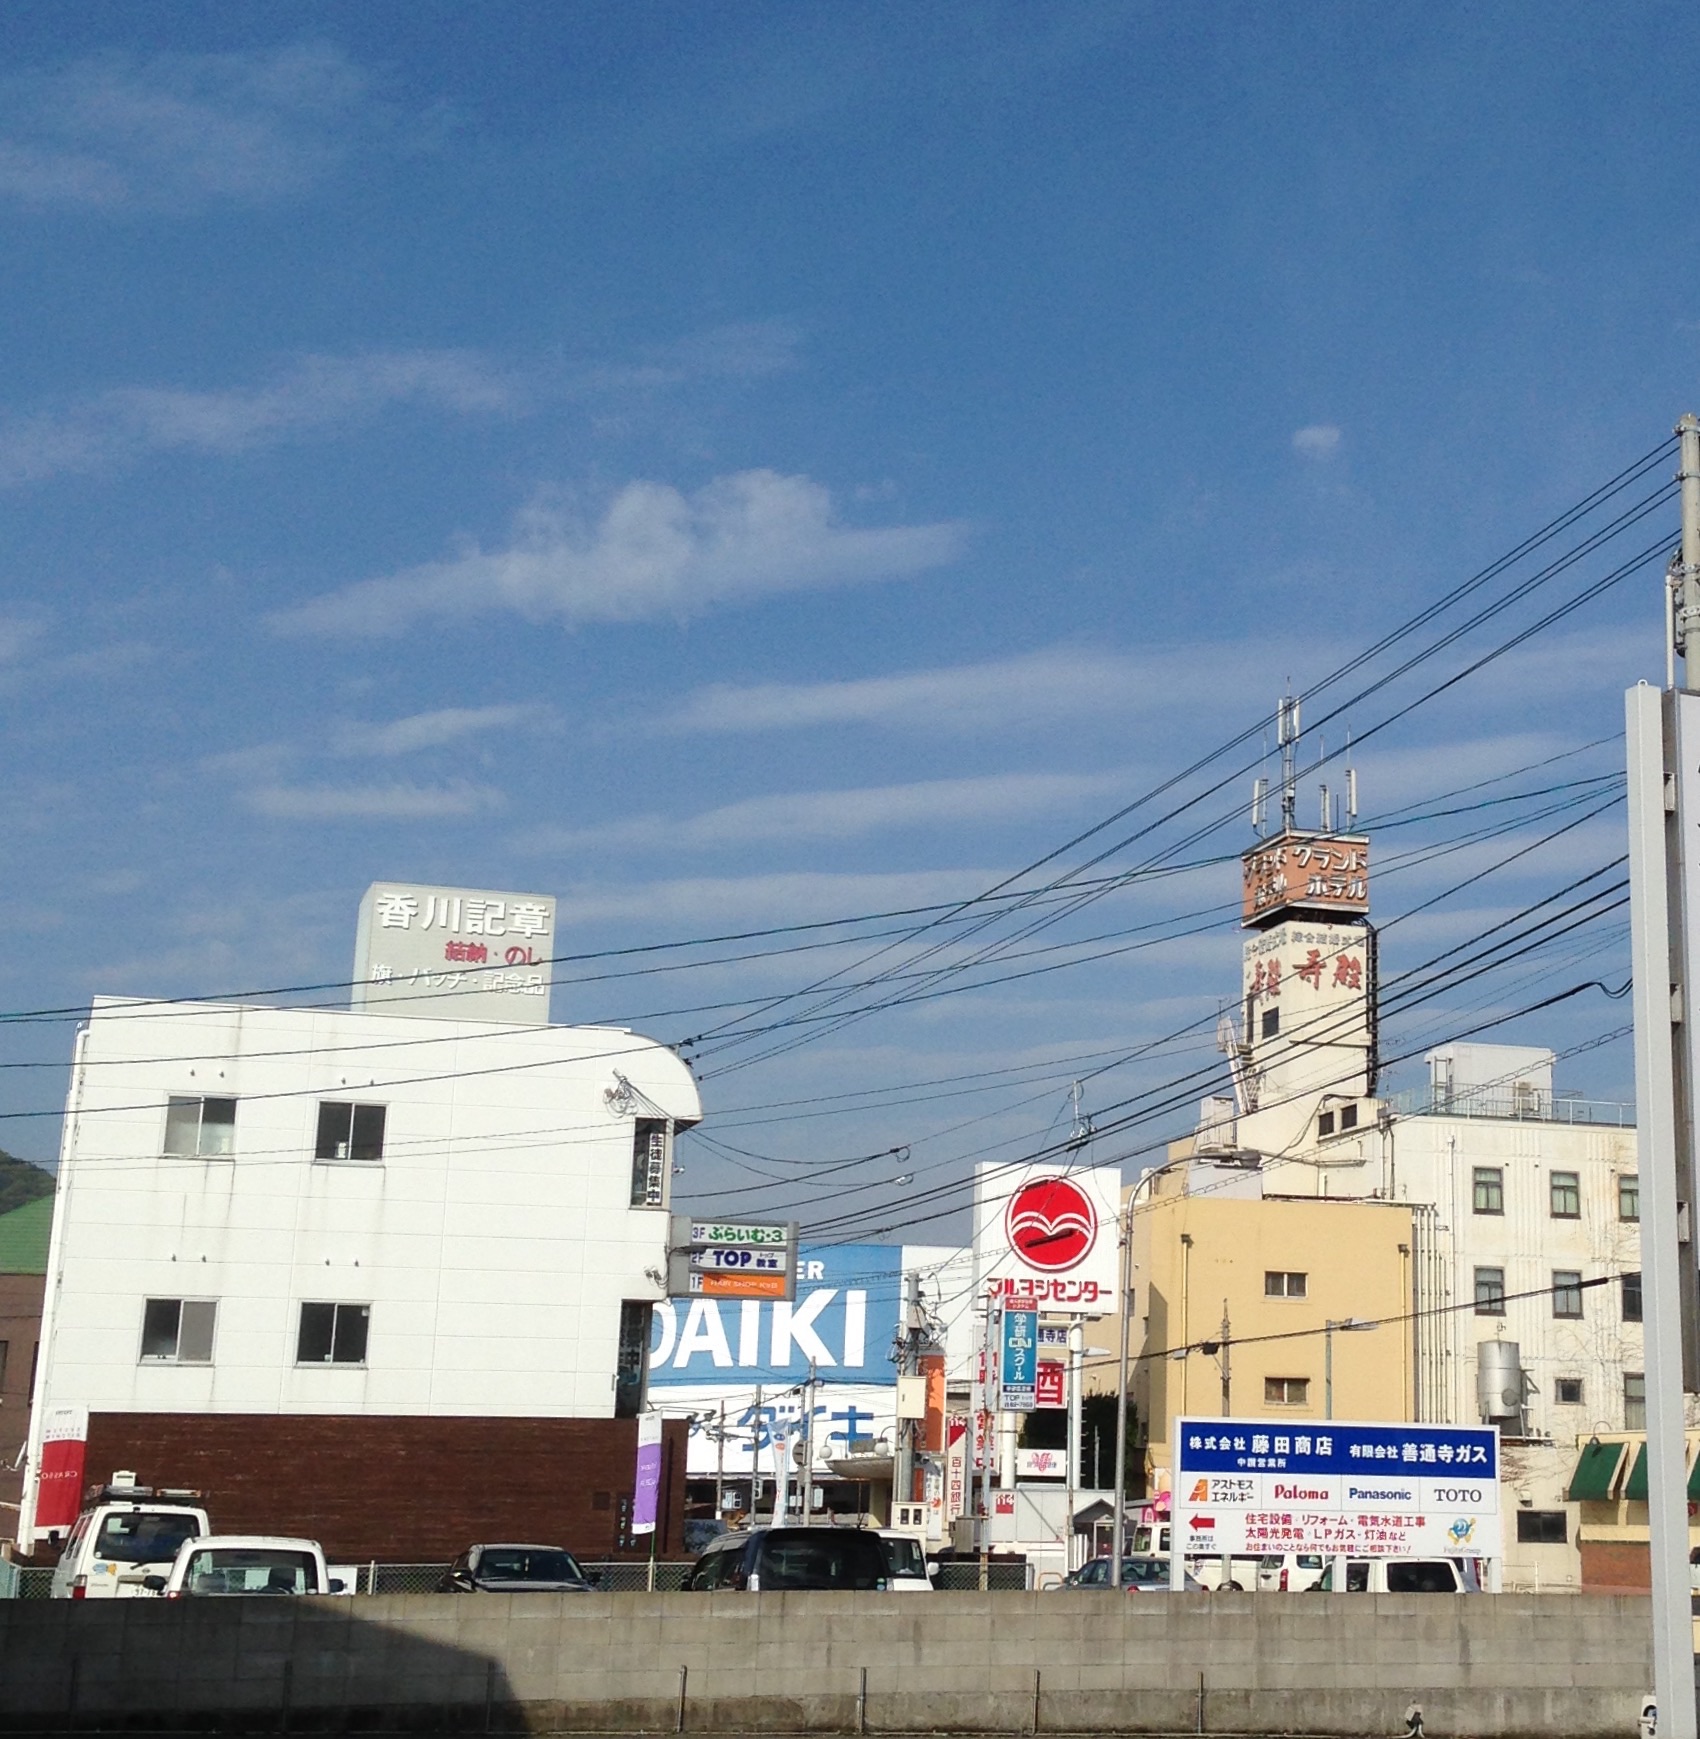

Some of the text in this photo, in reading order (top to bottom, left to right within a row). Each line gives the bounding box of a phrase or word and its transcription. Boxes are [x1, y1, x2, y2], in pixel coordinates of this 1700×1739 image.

[1305, 873, 1367, 900] ホテル
[377, 893, 550, 938] 香川記章
[692, 1227, 706, 1240] 3F
[713, 1250, 752, 1268] TOP
[691, 1276, 703, 1290] 1F
[737, 1405, 875, 1453] ダイキ
[1189, 1434, 1488, 1463] 株式会社 藤田商店 有限会社 善通寺ガス
[951, 1456, 962, 1515] 百十四銀行
[1211, 1479, 1254, 1490] アストモス
[1274, 1484, 1329, 1500] Paloma
[1211, 1492, 1254, 1503] エネルギー
[1349, 1487, 1412, 1500] Panasonic
[1434, 1489, 1482, 1502] TOTO
